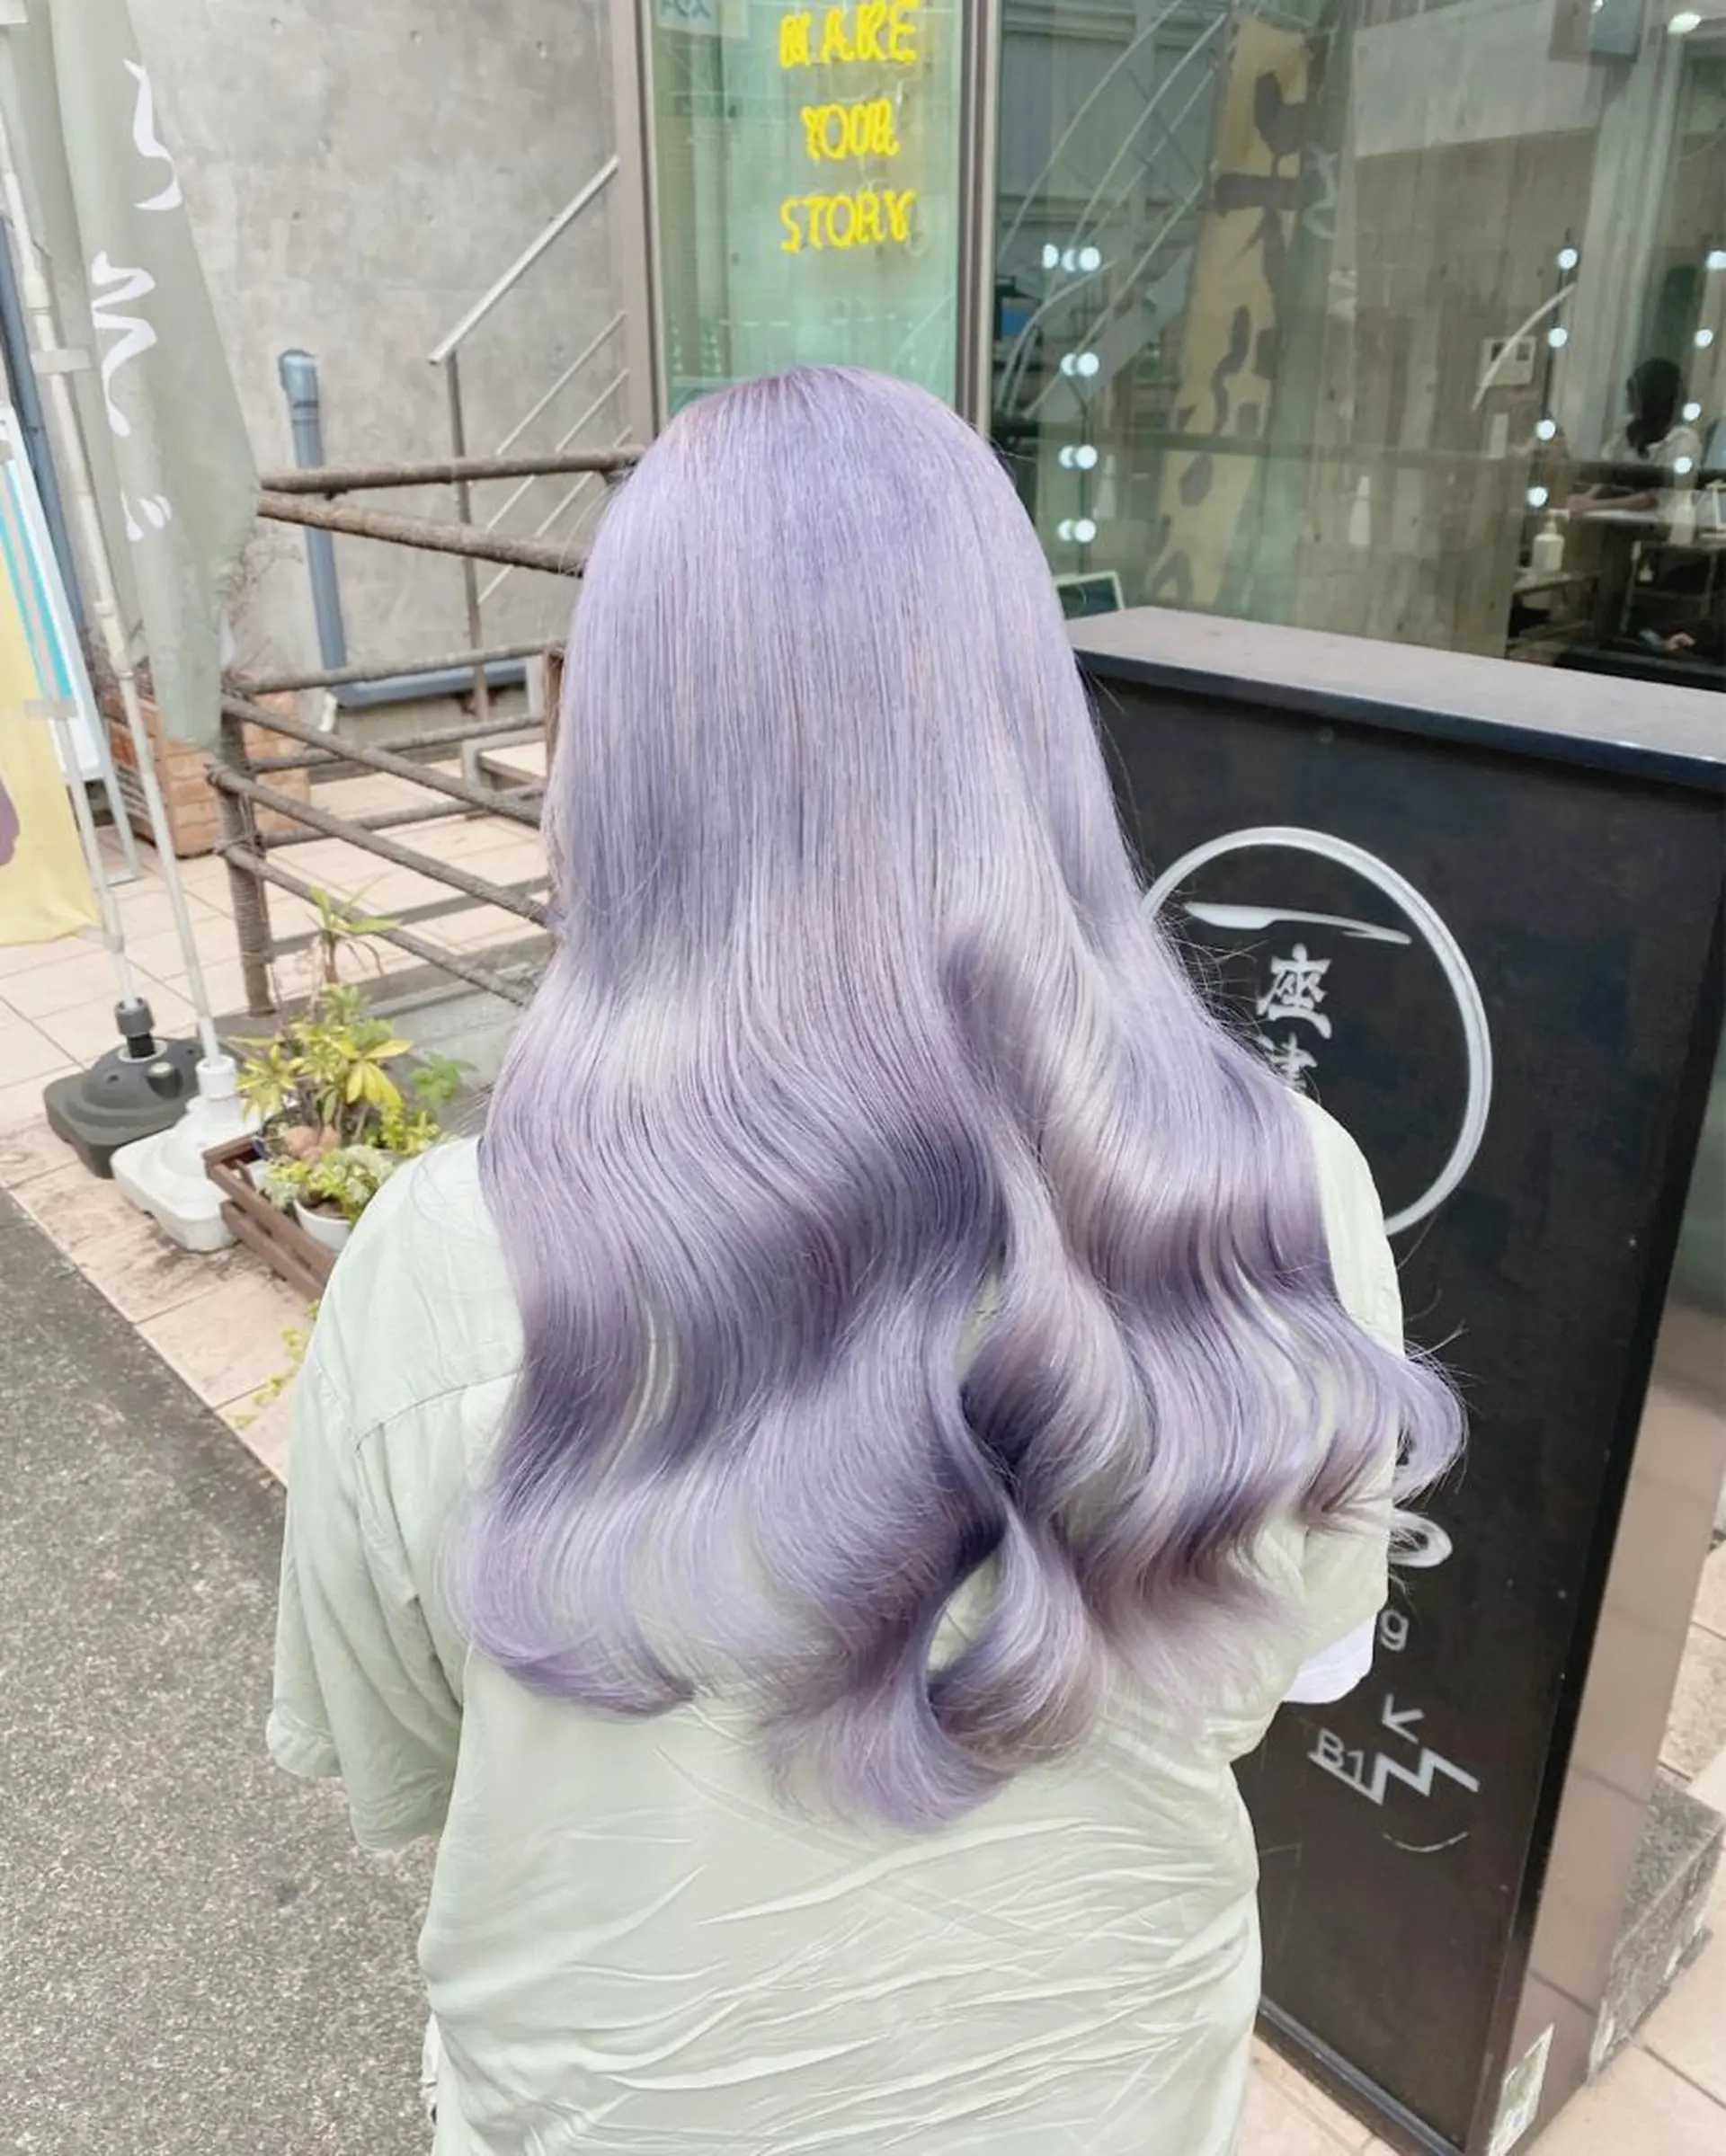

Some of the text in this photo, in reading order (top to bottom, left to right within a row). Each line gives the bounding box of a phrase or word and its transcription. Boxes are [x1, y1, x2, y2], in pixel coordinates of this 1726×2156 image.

[779, 0, 918, 68] MAKE
[801, 98, 900, 160] YOUR
[780, 189, 917, 253] STORY
[1317, 1726, 1365, 1783] B1
